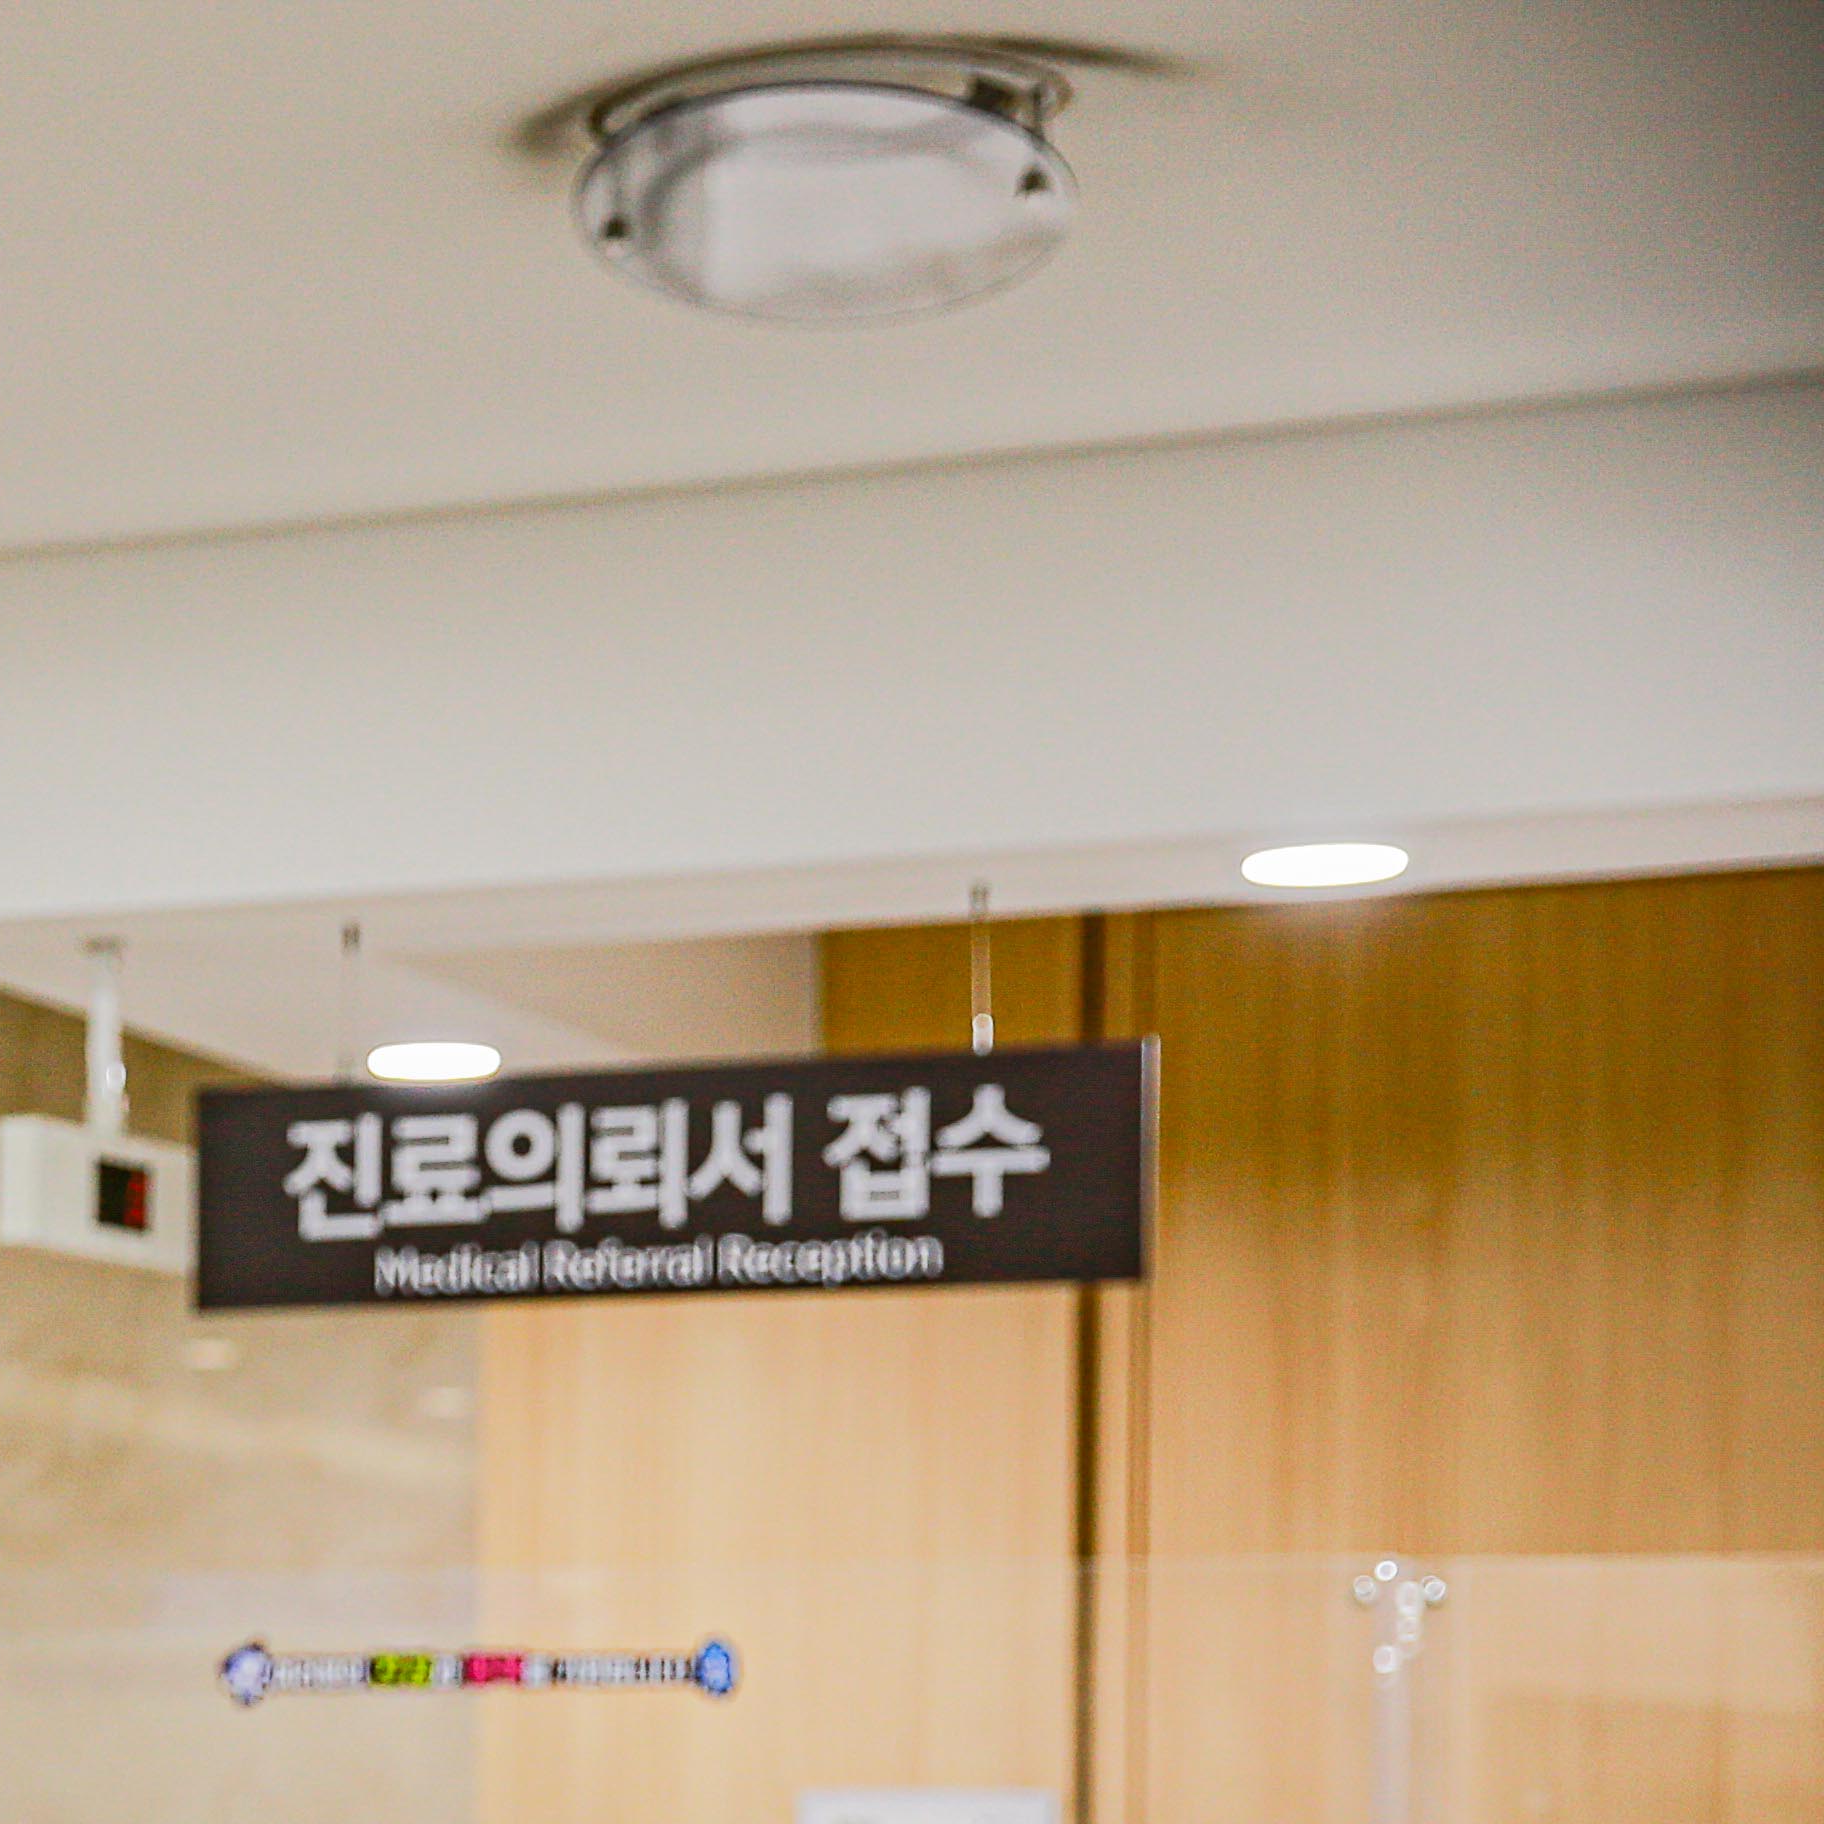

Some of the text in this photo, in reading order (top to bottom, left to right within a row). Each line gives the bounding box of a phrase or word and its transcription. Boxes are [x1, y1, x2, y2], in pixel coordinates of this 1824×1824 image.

[283, 1083, 1051, 1242] 진료의뢰서 접수
[373, 1231, 944, 1295] Medical Referral Reception
